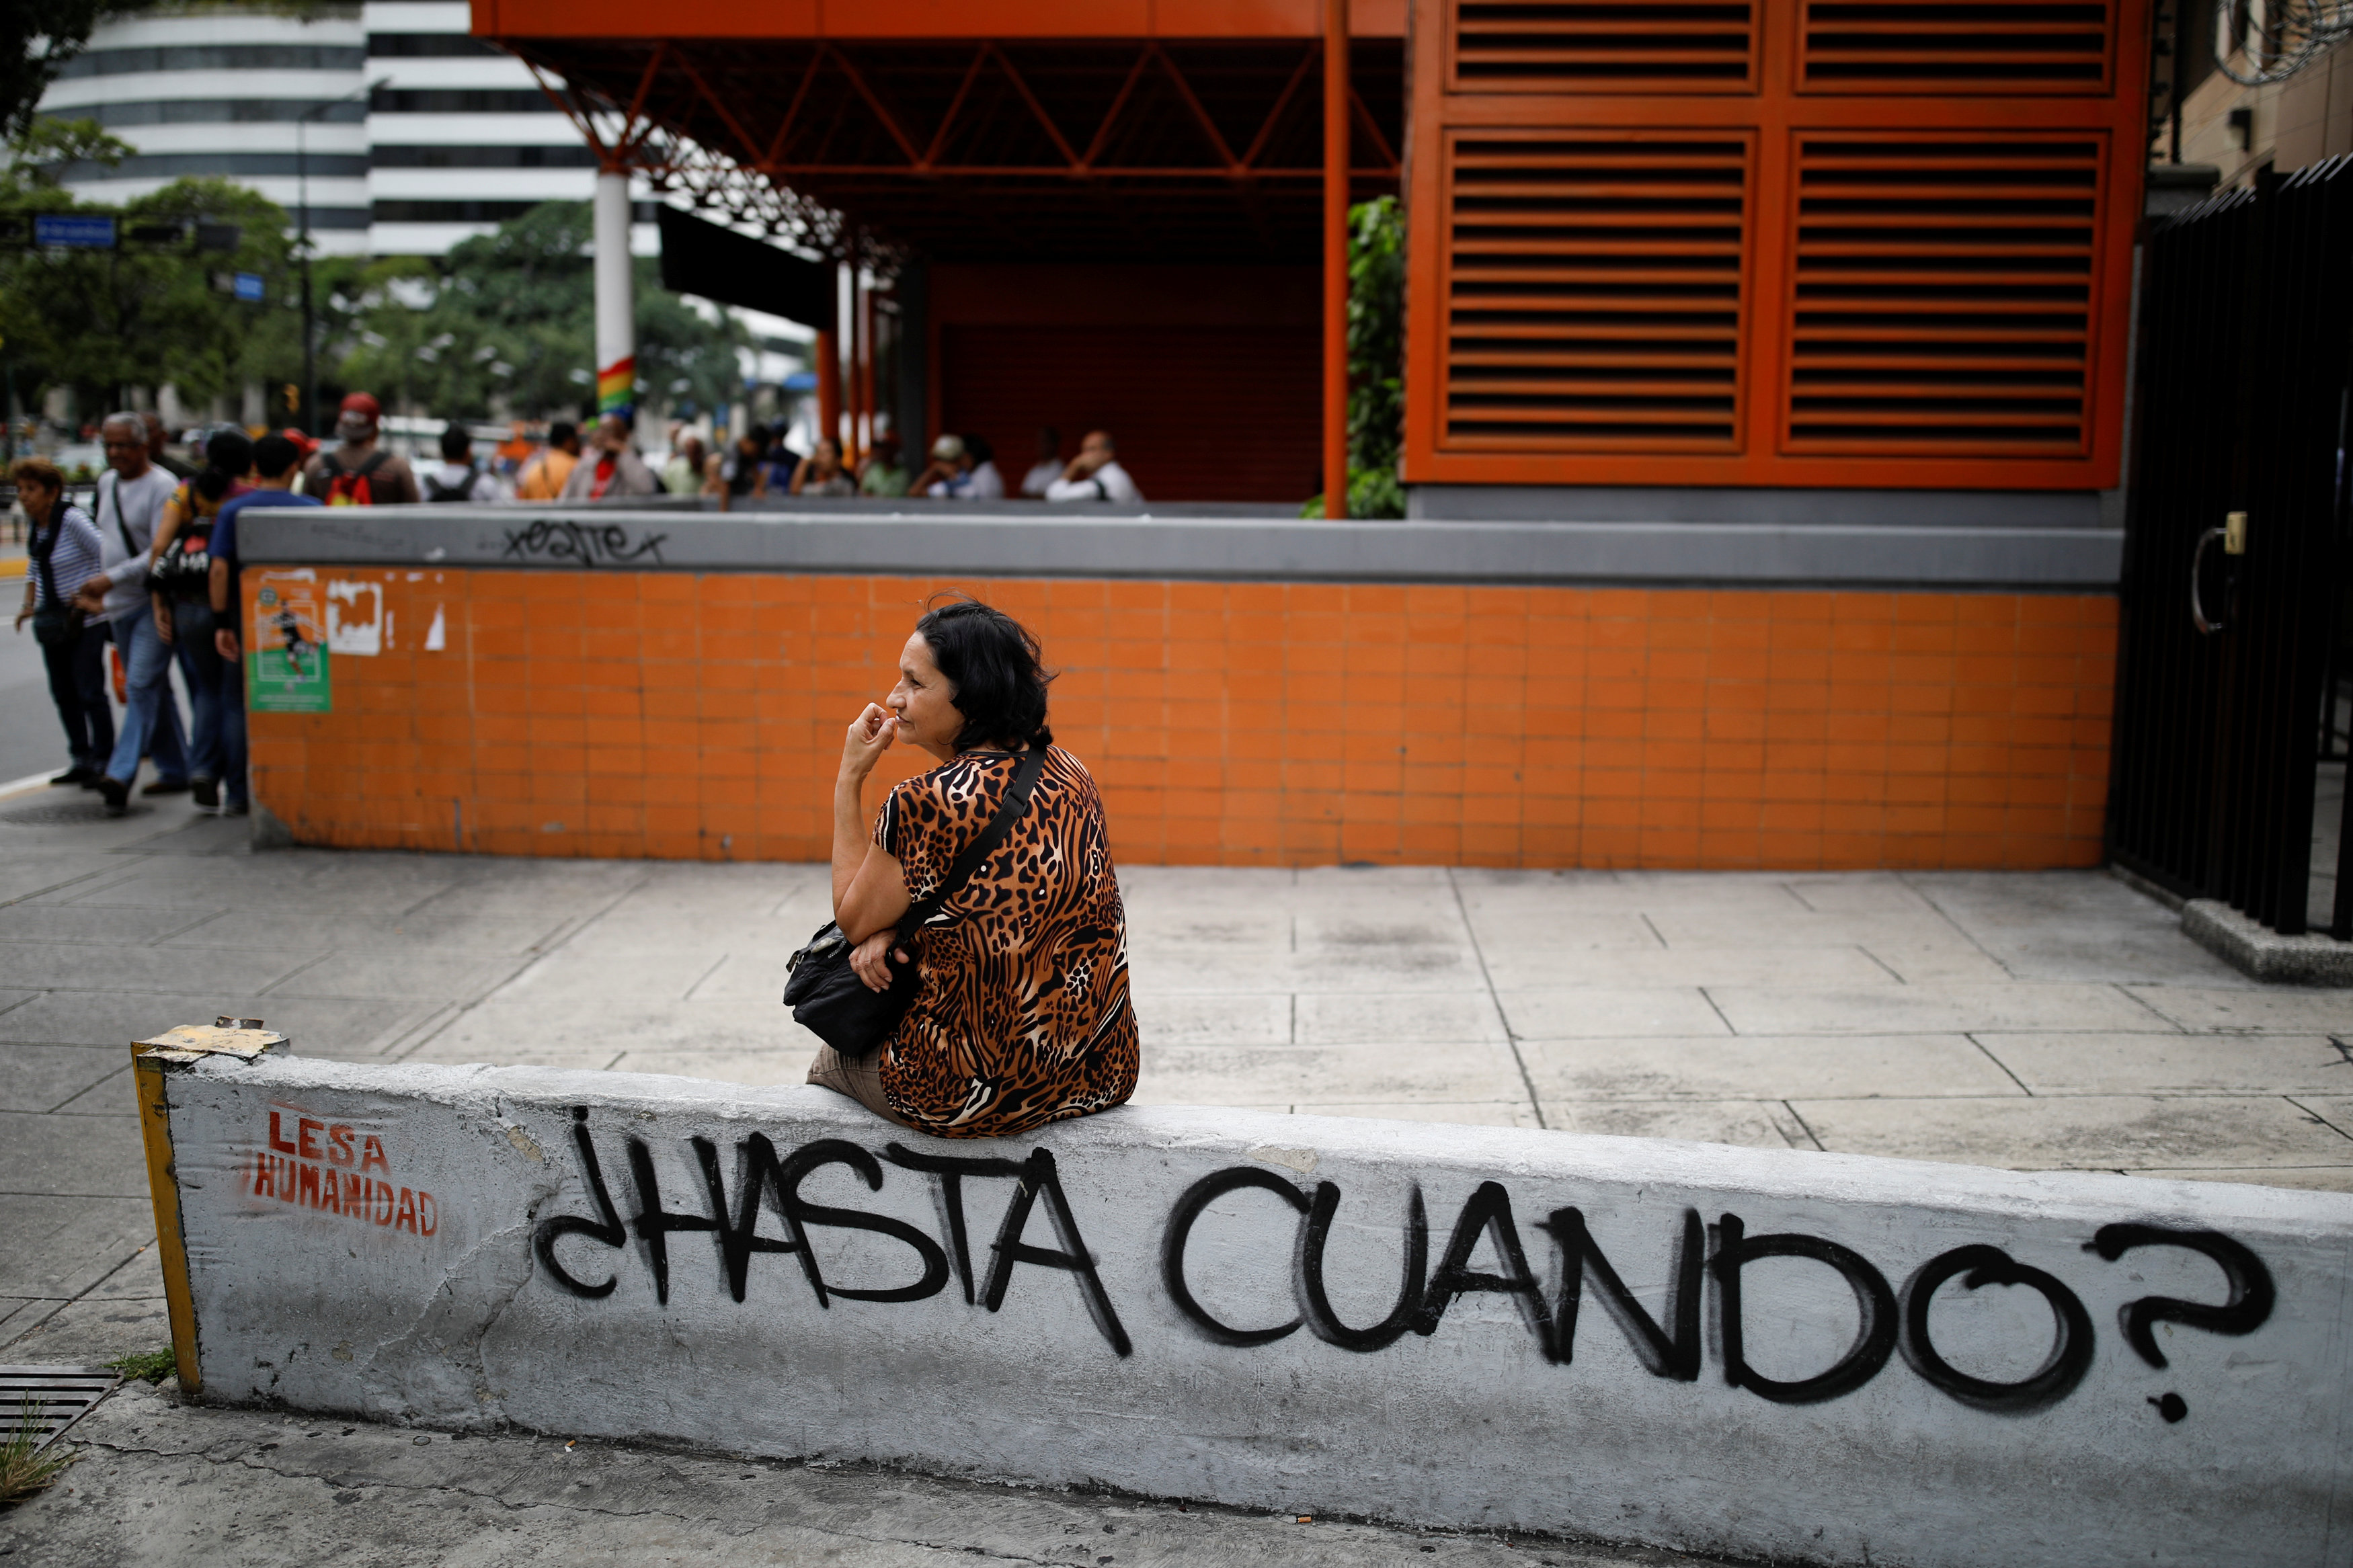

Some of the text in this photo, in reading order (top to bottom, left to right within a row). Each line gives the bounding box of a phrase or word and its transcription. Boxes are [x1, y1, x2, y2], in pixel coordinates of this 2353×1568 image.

[269, 1111, 392, 1175] LESA
[253, 1151, 438, 1237] HUMANIDAD
[531, 1104, 2277, 1424] ¿HASTA CUANDO?
